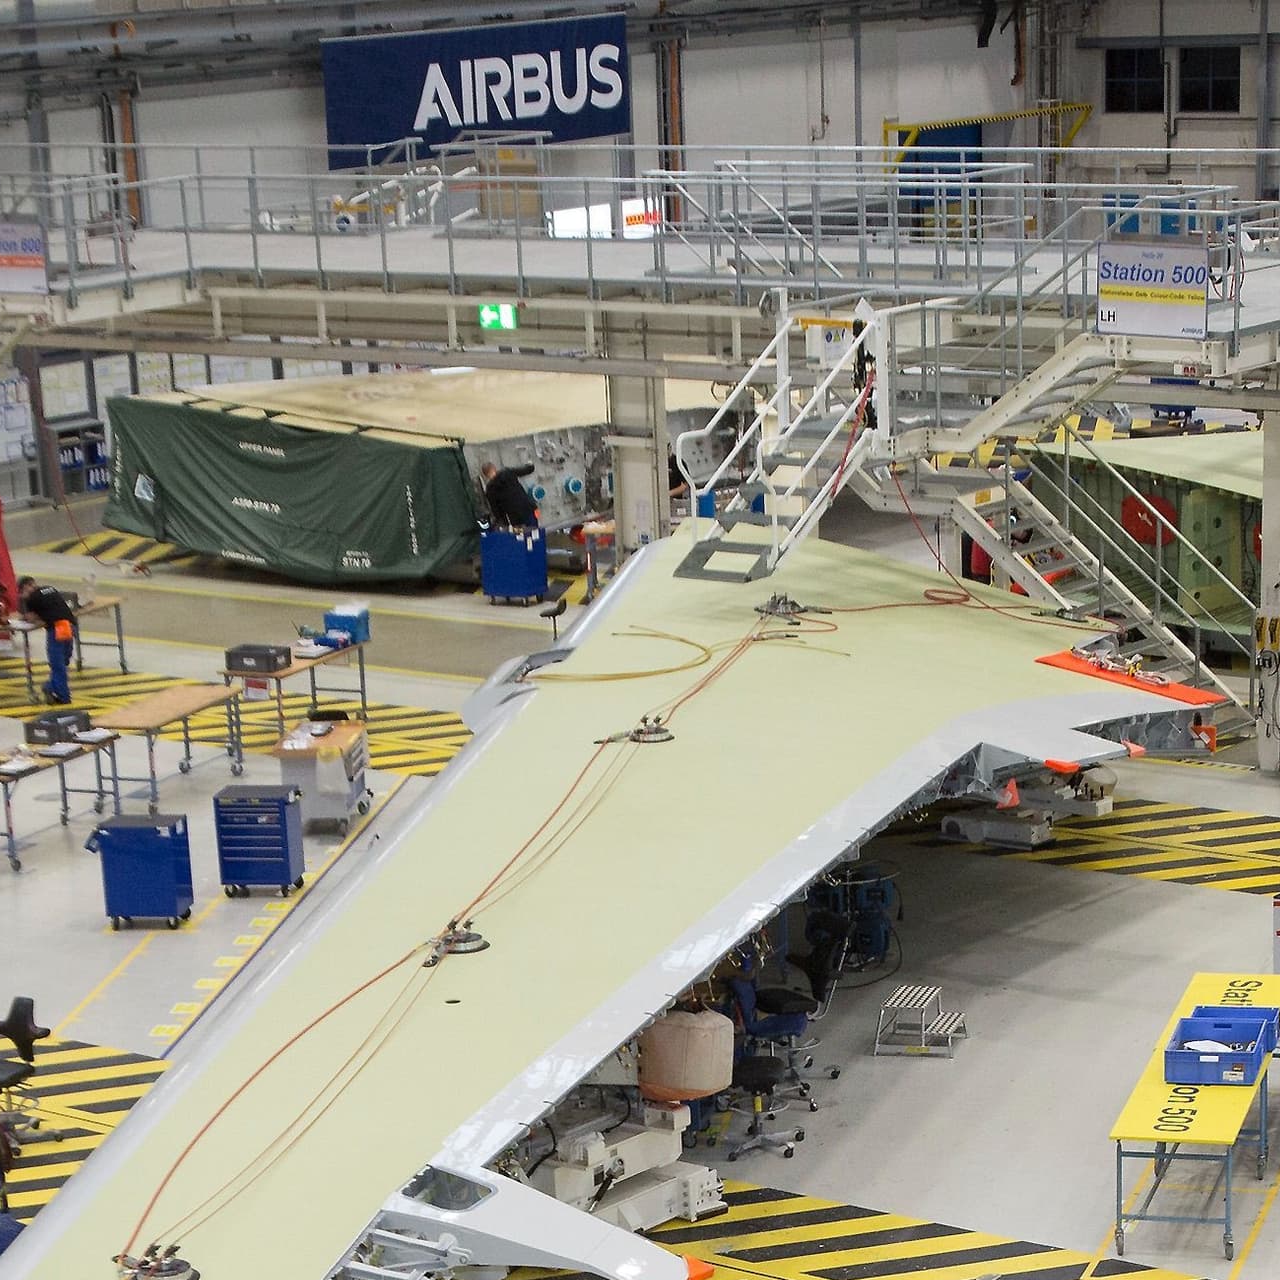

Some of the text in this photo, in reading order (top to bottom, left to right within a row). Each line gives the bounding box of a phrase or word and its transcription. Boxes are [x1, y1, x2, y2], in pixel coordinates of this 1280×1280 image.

[413, 43, 623, 131] AIRBUS
[1100, 261, 1207, 285] Station 500
[1100, 310, 1116, 322] LH
[342, 557, 371, 568] STN 70
[1153, 1106, 1198, 1133] 500
